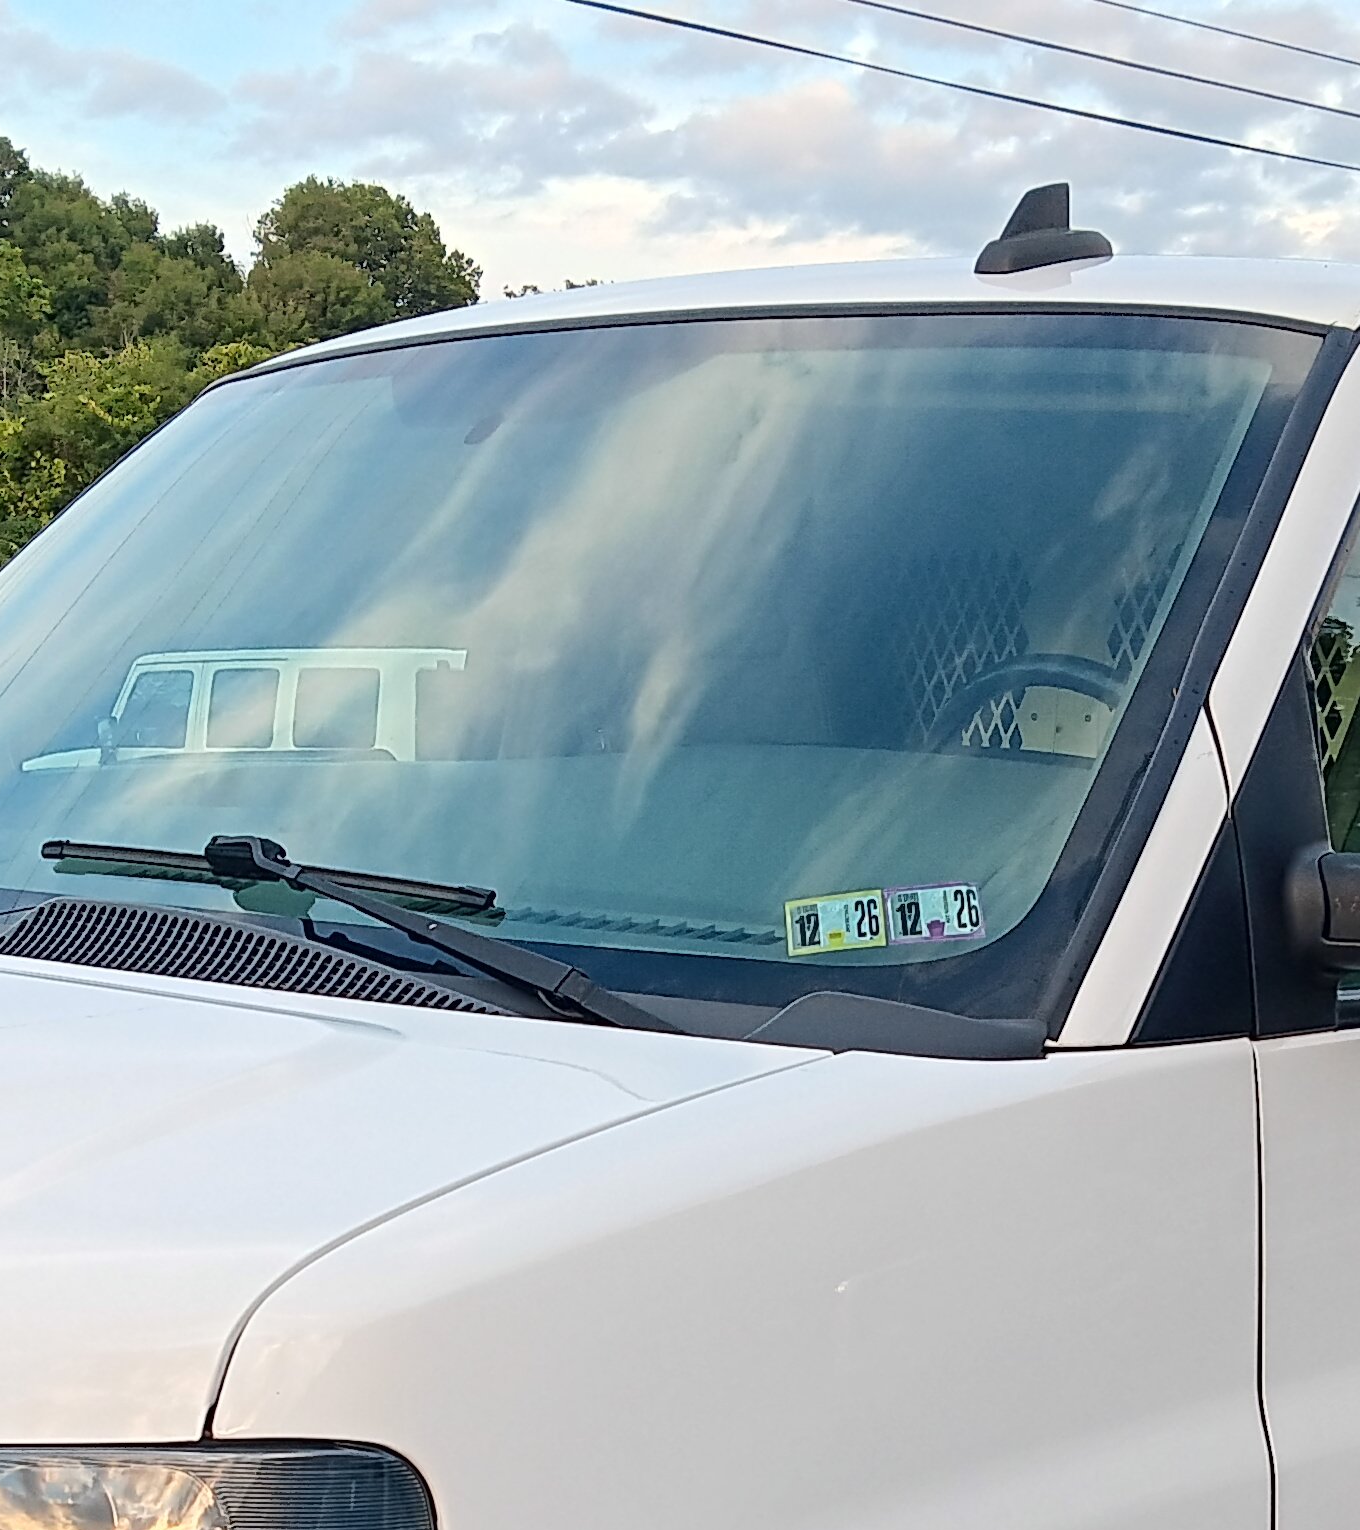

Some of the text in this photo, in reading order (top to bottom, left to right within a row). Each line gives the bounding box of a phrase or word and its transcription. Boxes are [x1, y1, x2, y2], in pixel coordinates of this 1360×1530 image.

[795, 913, 821, 947] 12
[854, 898, 880, 938] 26
[895, 901, 922, 937] 12
[953, 889, 980, 929] 26
